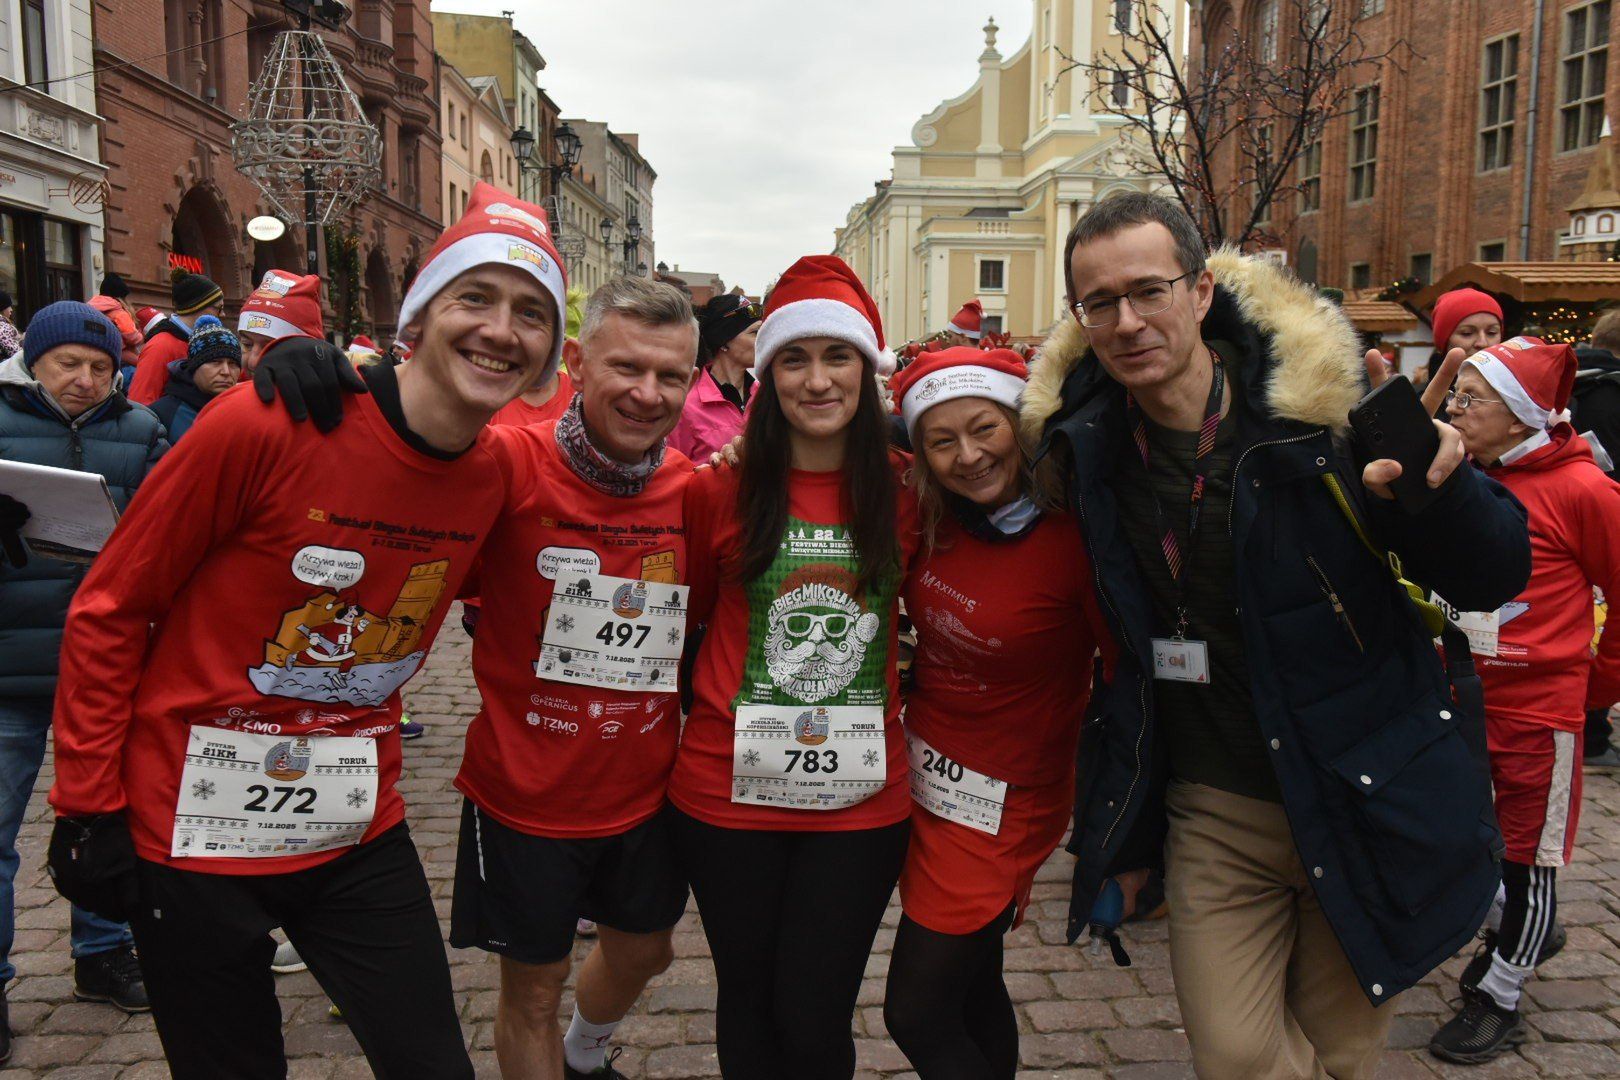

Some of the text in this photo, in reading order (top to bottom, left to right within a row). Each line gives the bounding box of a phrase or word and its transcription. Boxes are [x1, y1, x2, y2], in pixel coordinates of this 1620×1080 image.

[919, 570, 977, 613] MAXIMUS
[595, 620, 652, 650] 497
[605, 654, 636, 664] 7.12.2025
[542, 716, 579, 733] TZMO
[202, 747, 237, 759] 21KM
[783, 749, 838, 774] 783
[921, 748, 964, 783] 240
[243, 784, 318, 814] 272
[257, 822, 297, 830] 7.12.2025
